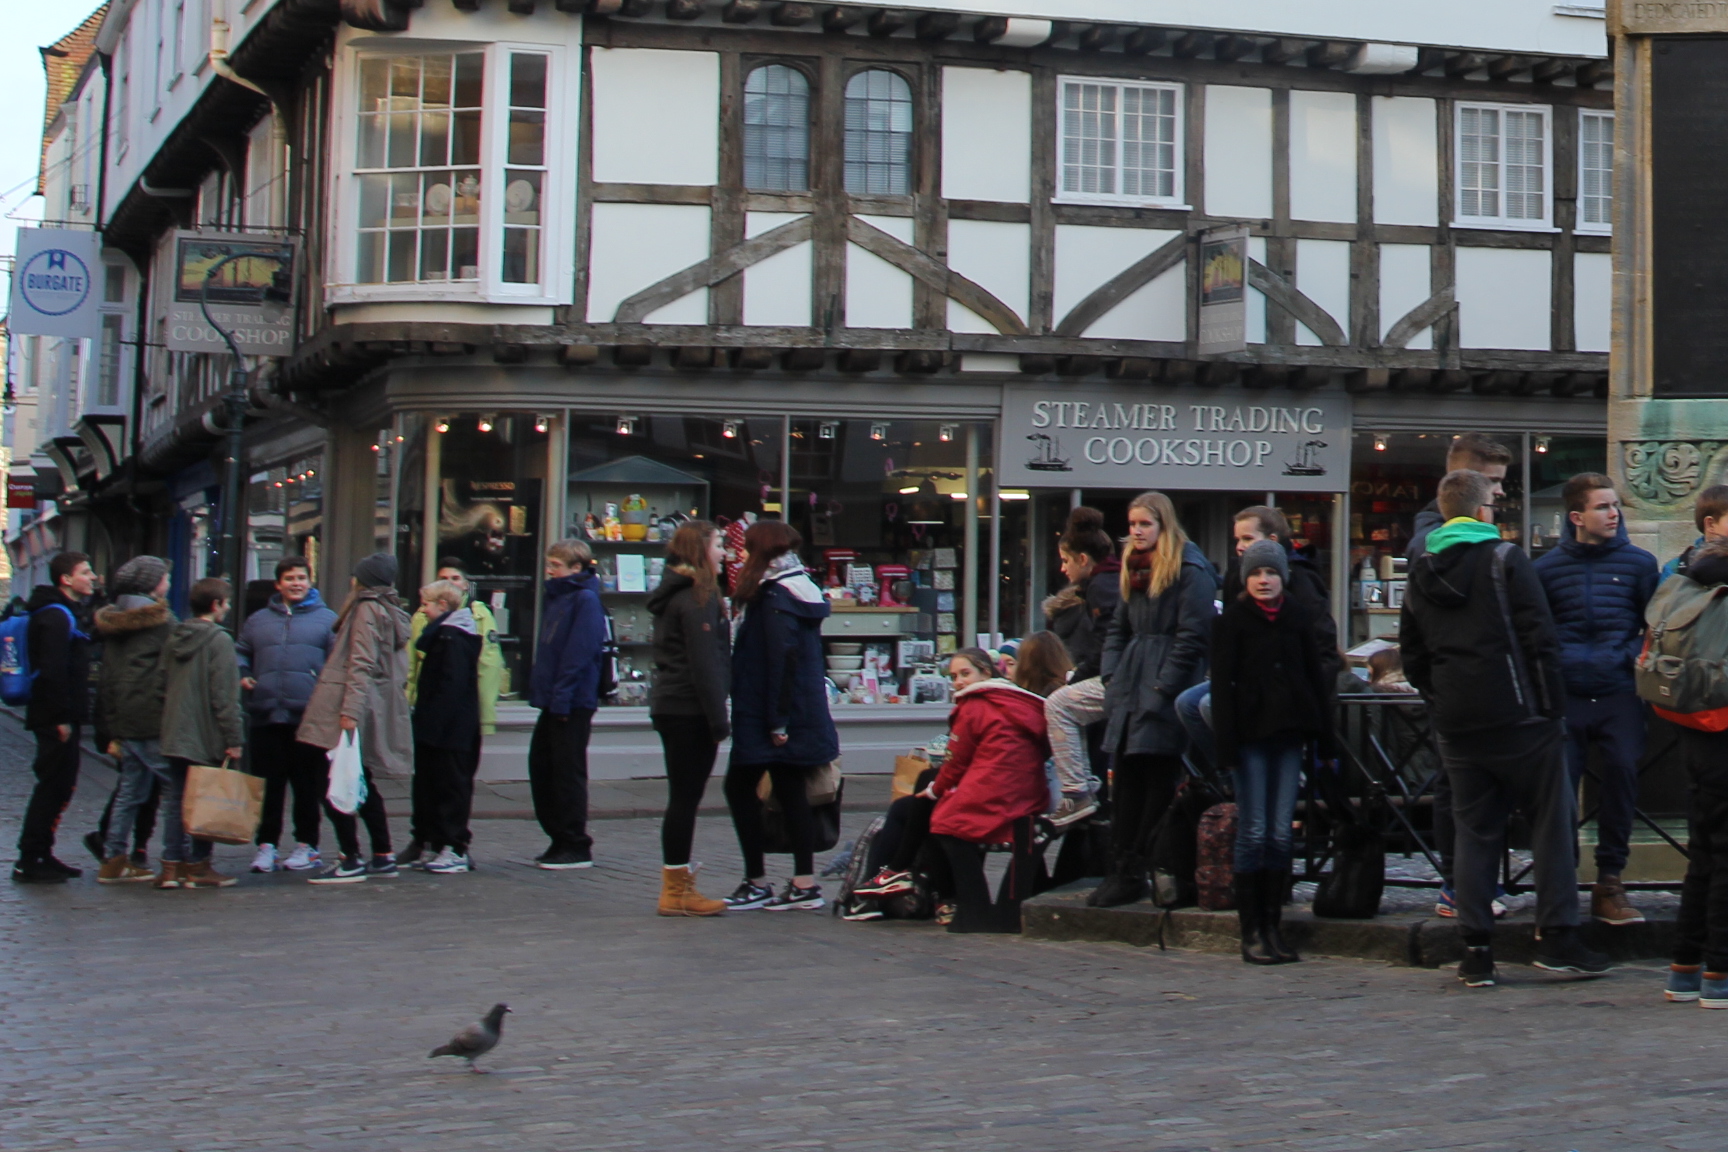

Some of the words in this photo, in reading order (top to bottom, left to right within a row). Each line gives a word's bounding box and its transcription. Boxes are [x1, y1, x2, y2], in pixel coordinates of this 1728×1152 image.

[27, 273, 83, 292] BURGATE
[172, 326, 290, 345] COOSHOP
[1031, 400, 1178, 431] STEAMER
[1190, 405, 1324, 435] TRADING
[1084, 436, 1273, 468] COOKSHOP
